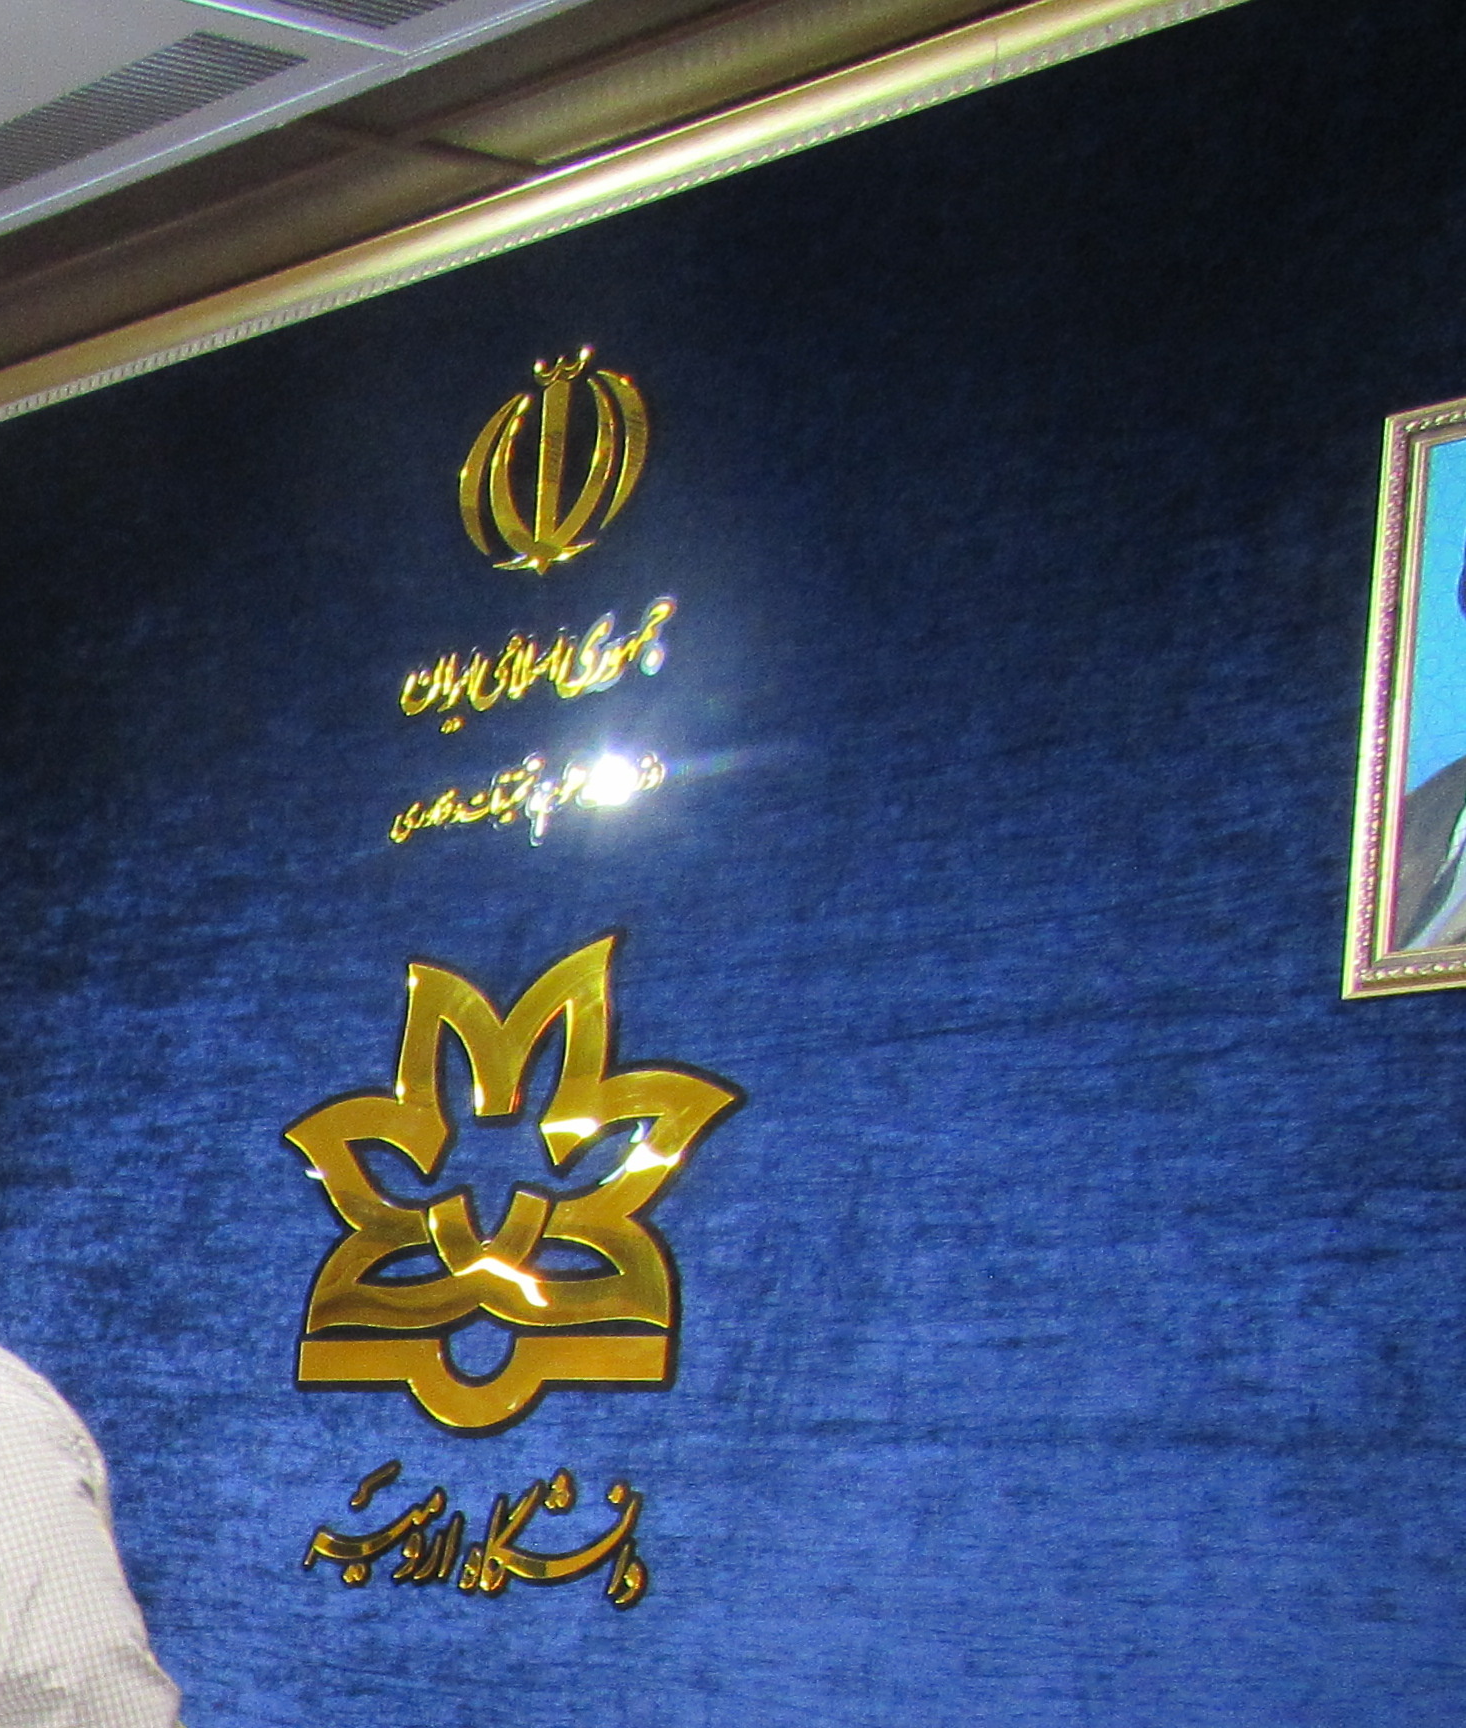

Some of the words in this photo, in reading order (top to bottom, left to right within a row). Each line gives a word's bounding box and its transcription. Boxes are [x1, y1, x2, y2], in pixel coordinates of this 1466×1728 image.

[399, 649, 481, 735] ایران
[470, 631, 567, 712] اسلامی
[554, 599, 675, 699] جمهوری
[304, 1460, 464, 1586] ارومیه
[459, 1468, 646, 1606] دانشگاه
